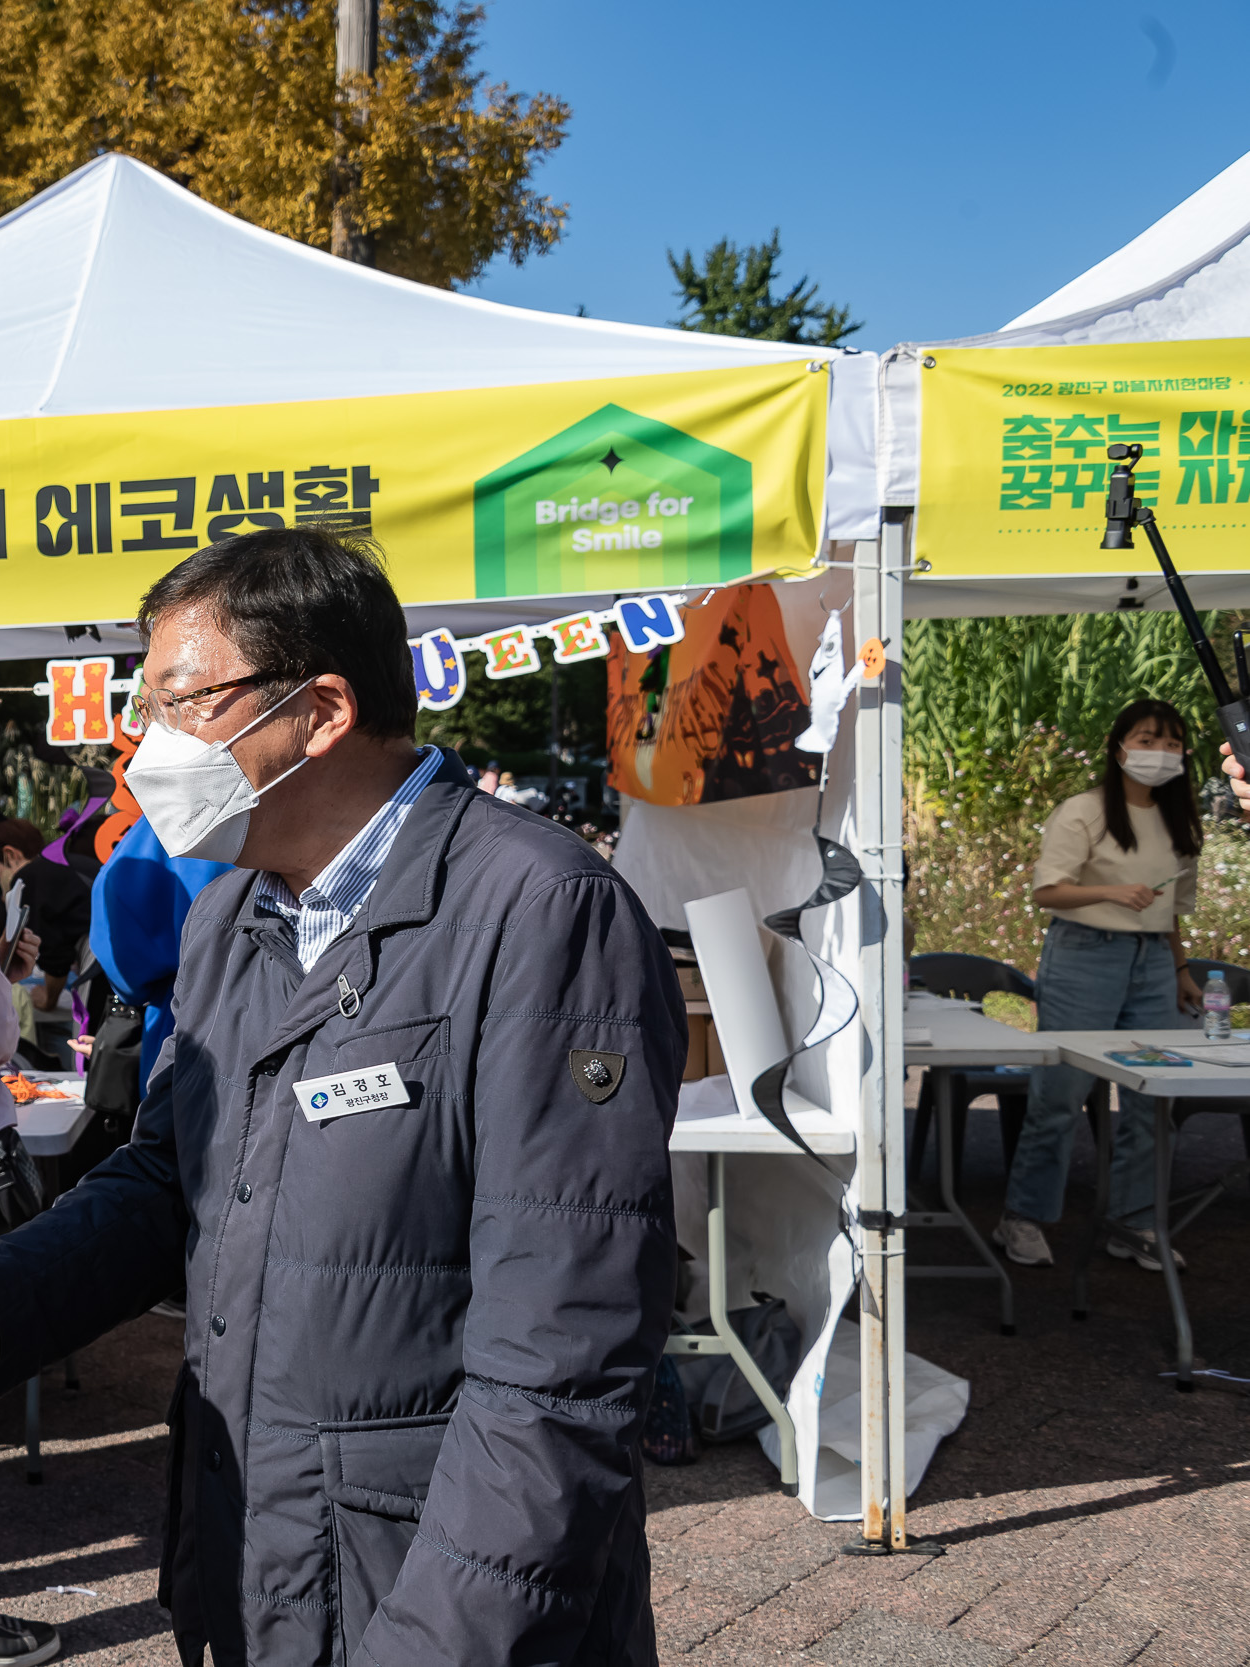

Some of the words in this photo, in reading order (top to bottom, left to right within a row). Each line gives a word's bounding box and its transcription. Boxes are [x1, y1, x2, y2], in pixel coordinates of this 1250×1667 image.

[1002, 383, 1053, 397] 2022
[1057, 381, 1108, 396] 광진구
[1113, 377, 1232, 393] 마을자치한마당
[1002, 413, 1161, 461] 춤추는
[35, 465, 380, 558] 에코생활
[535, 496, 641, 526] Bridge
[646, 490, 695, 518] for
[571, 523, 663, 553] Smile
[345, 1091, 389, 1108] 광진구청장
